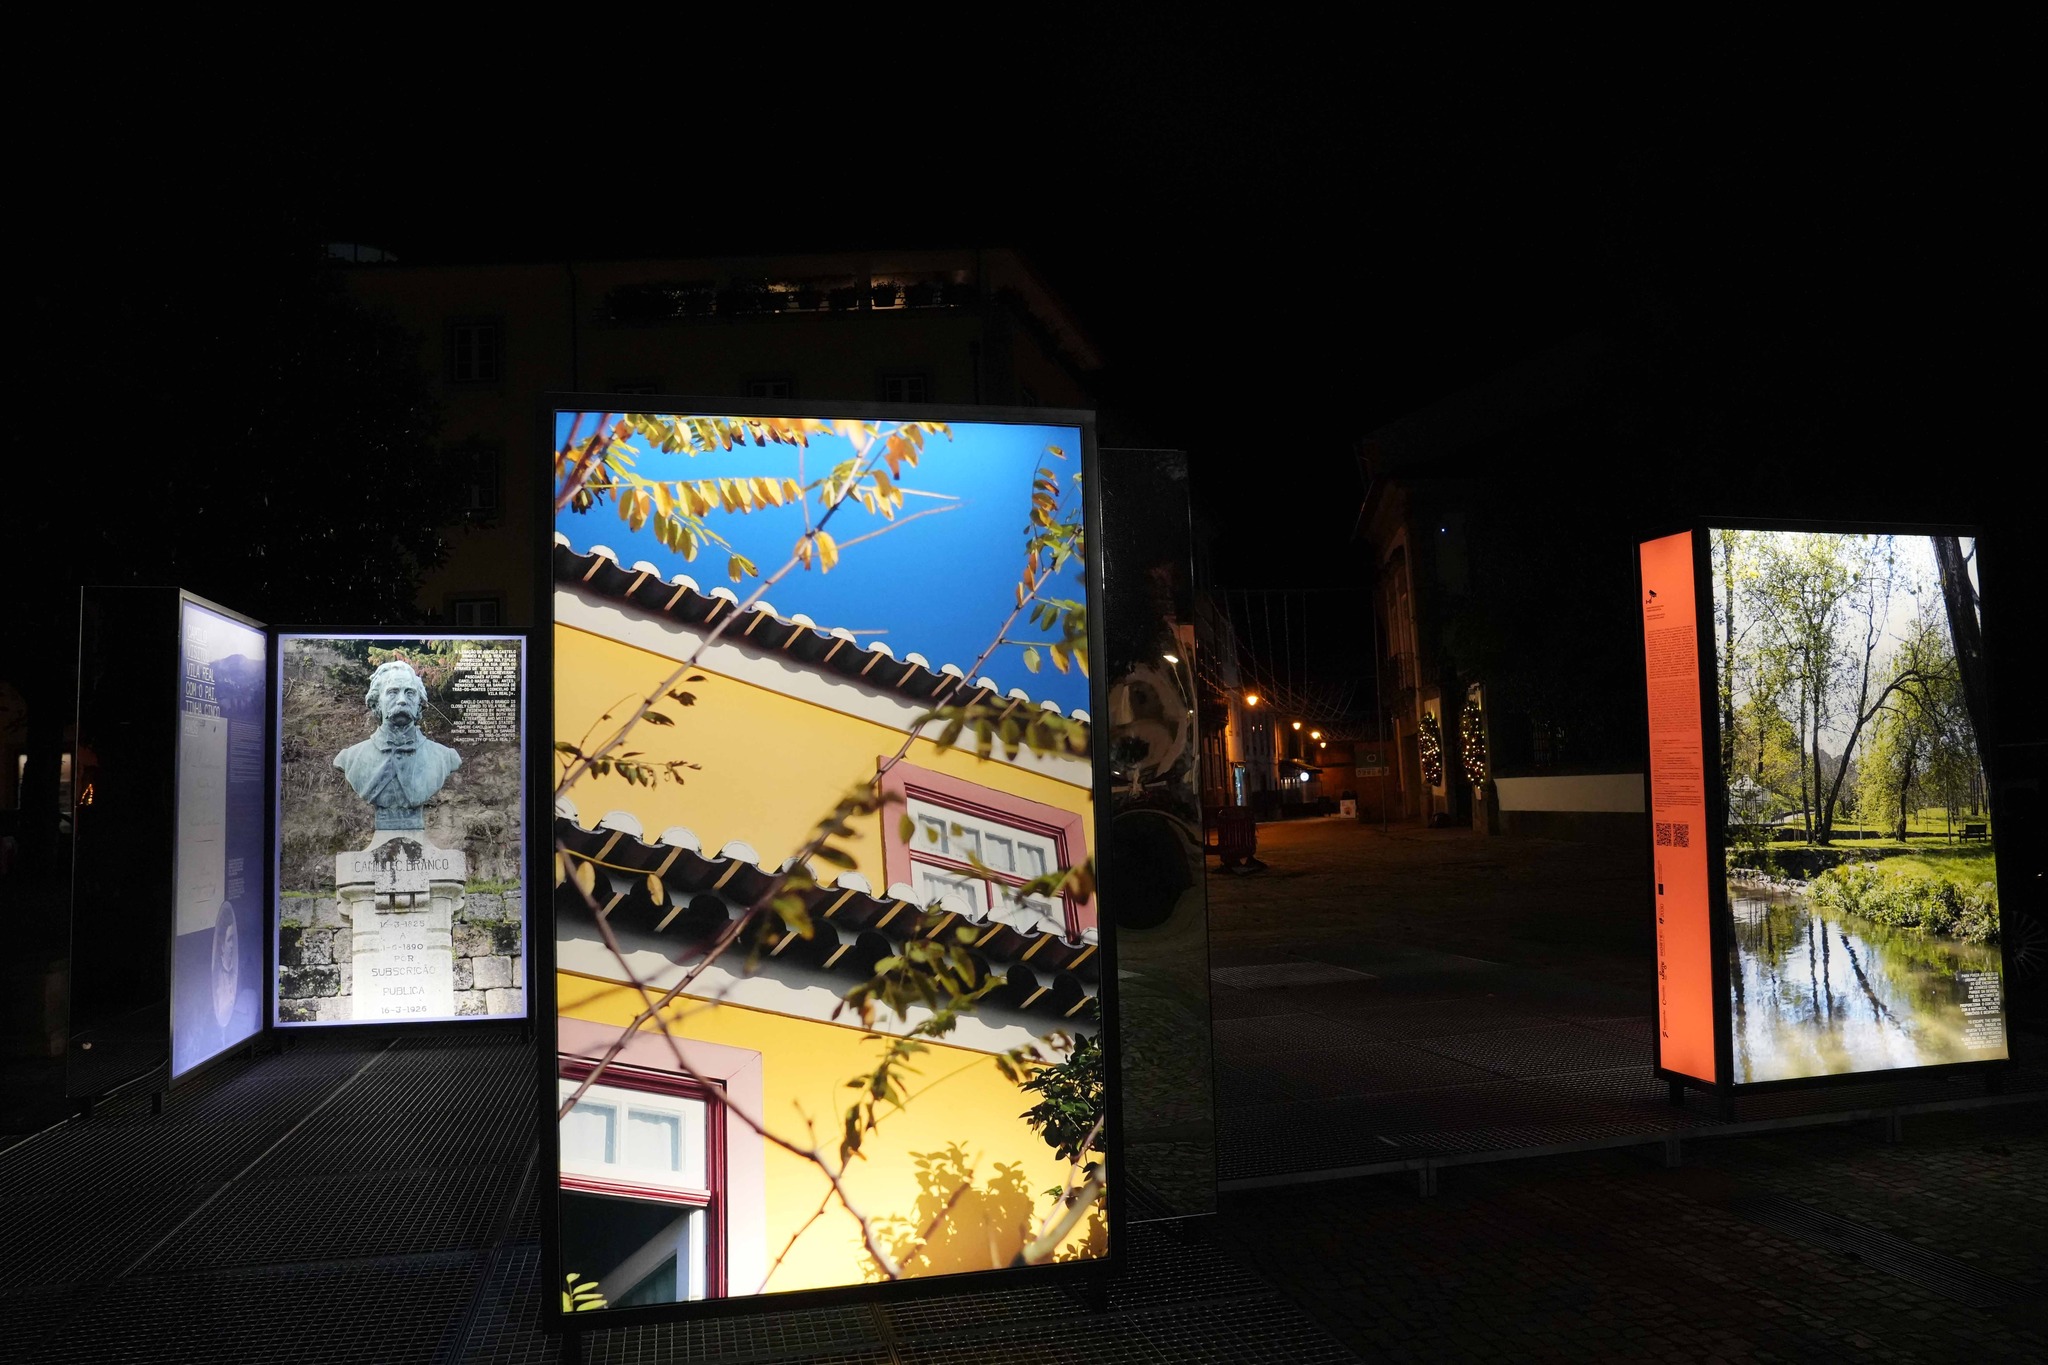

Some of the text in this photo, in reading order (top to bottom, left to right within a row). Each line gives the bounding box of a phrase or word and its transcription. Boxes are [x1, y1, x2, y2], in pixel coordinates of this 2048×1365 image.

[187, 662, 214, 682] VILA REAL
[186, 682, 217, 700] COM O PAI,
[186, 700, 220, 718] TINHA CINCO
[354, 861, 392, 872] CAMILO
[381, 1005, 427, 1014] 16-3-1926
